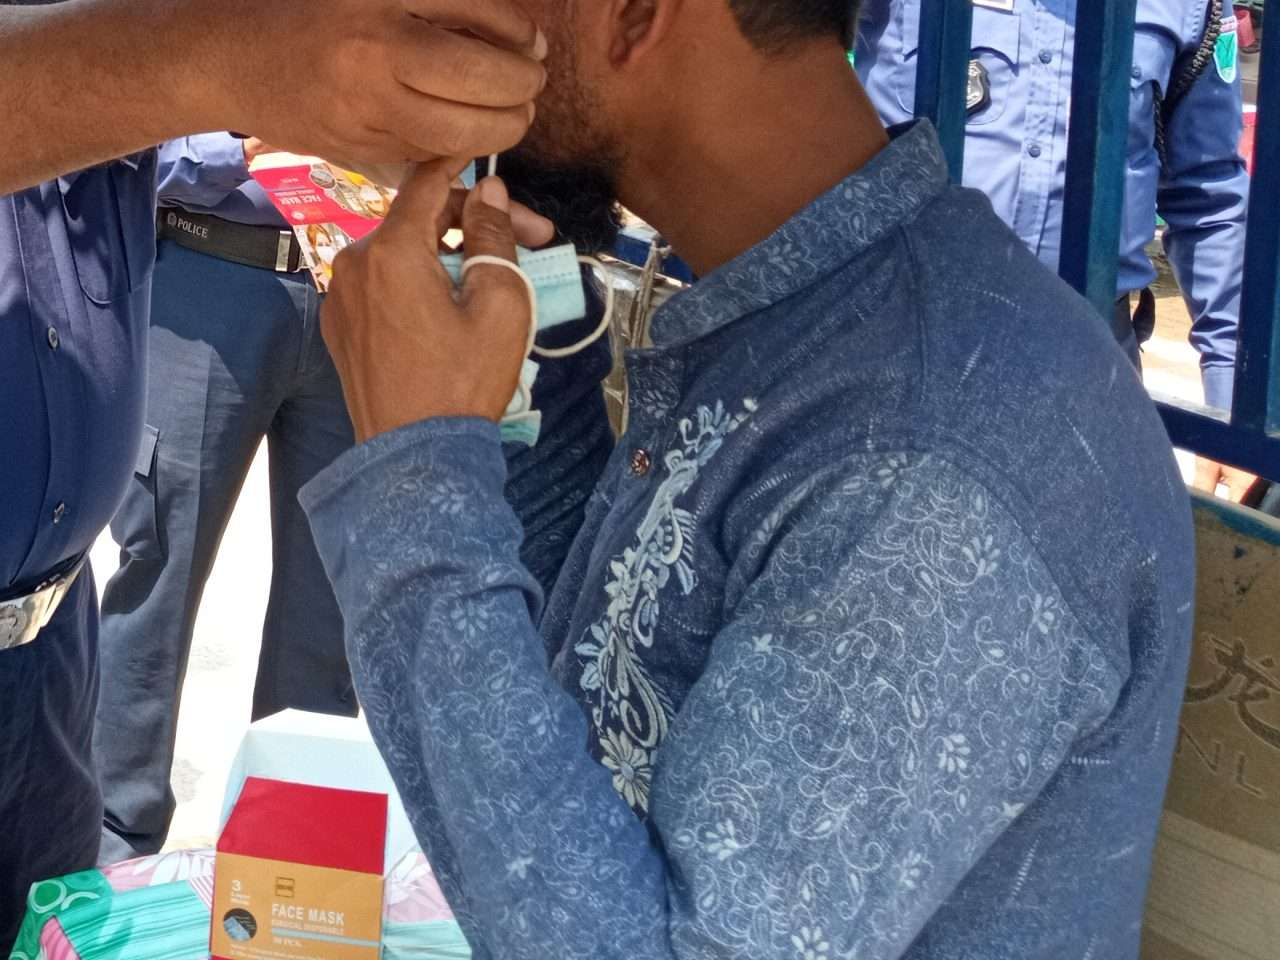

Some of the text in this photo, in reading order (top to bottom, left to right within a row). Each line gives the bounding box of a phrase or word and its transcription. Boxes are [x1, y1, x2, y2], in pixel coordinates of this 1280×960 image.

[176, 217, 209, 239] POLICE
[231, 879, 241, 891] 3
[271, 903, 345, 926] FACE MASK
